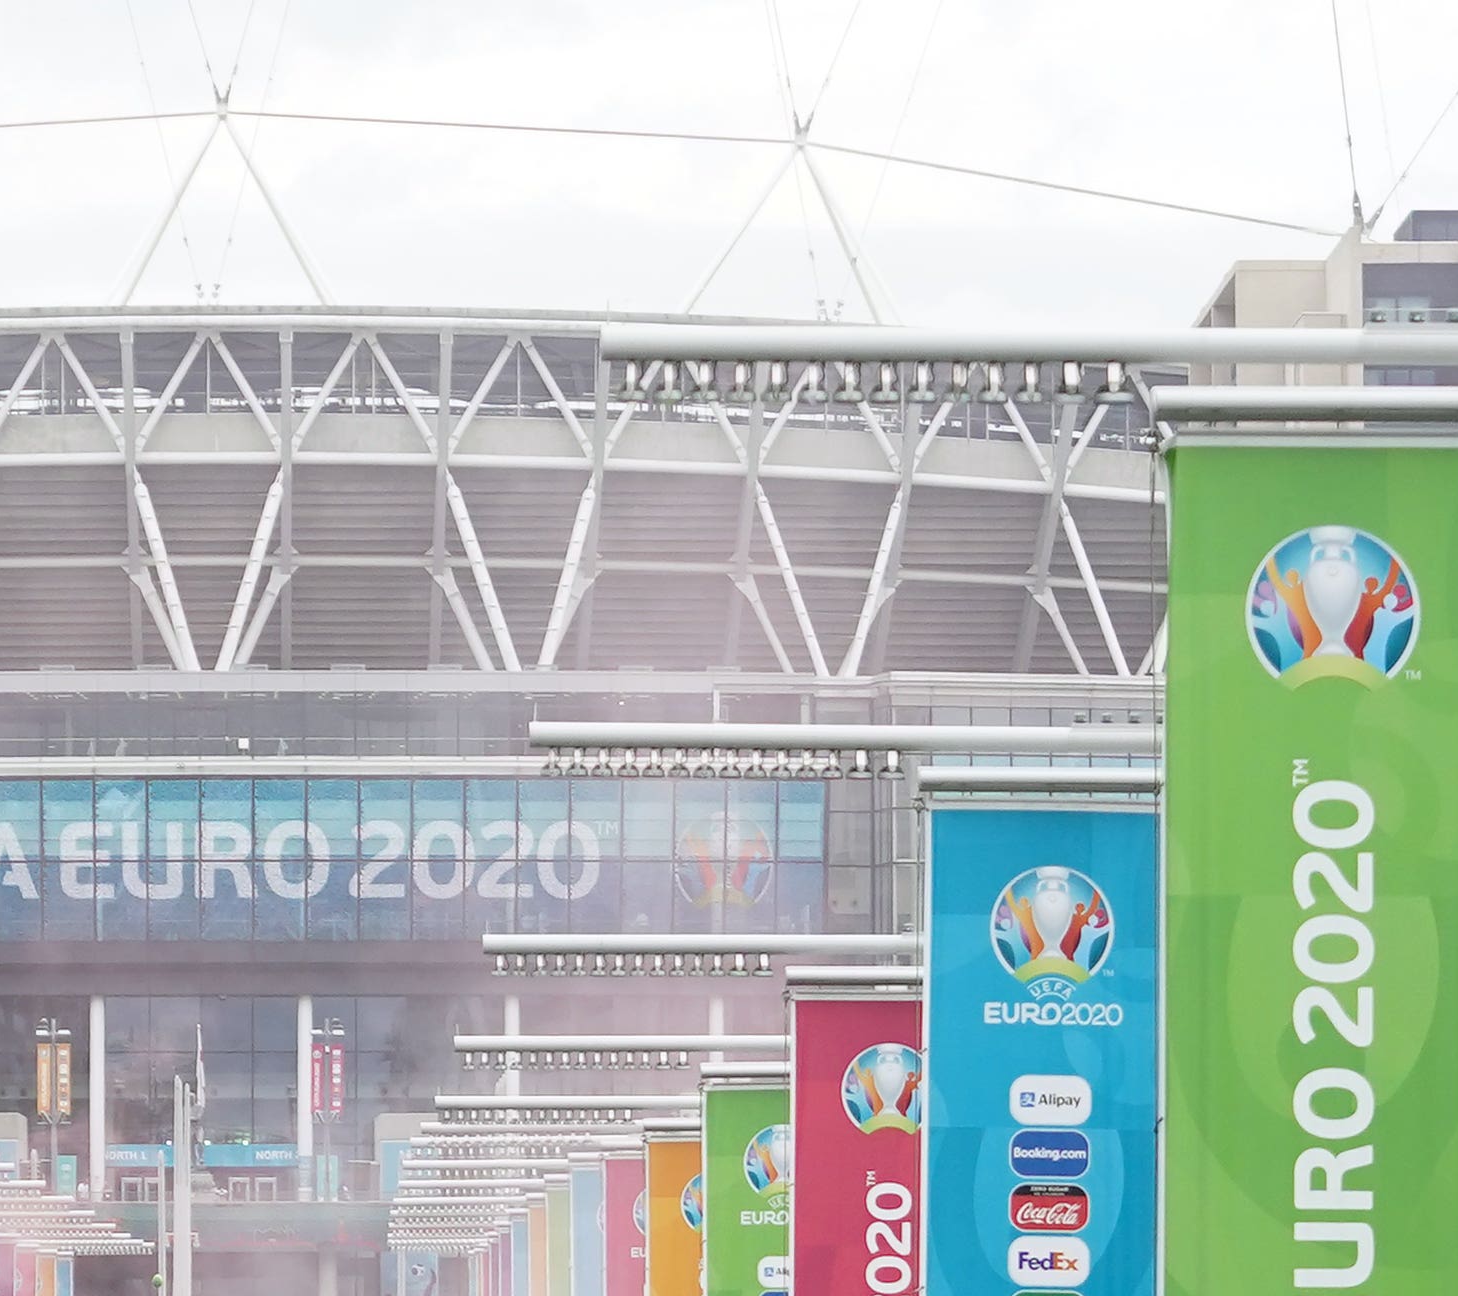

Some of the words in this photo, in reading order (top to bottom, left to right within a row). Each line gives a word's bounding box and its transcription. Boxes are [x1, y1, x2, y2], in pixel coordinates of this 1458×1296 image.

[58, 820, 329, 899] EURO
[347, 819, 598, 899] 2020
[1293, 778, 1375, 1051] 2020
[1030, 981, 1072, 999] UEFA
[983, 1002, 1123, 1026] EURO2020
[1038, 1092, 1082, 1107] Alipay
[1014, 1146, 1087, 1161] Booking.com
[1018, 1252, 1078, 1271] FedEx
